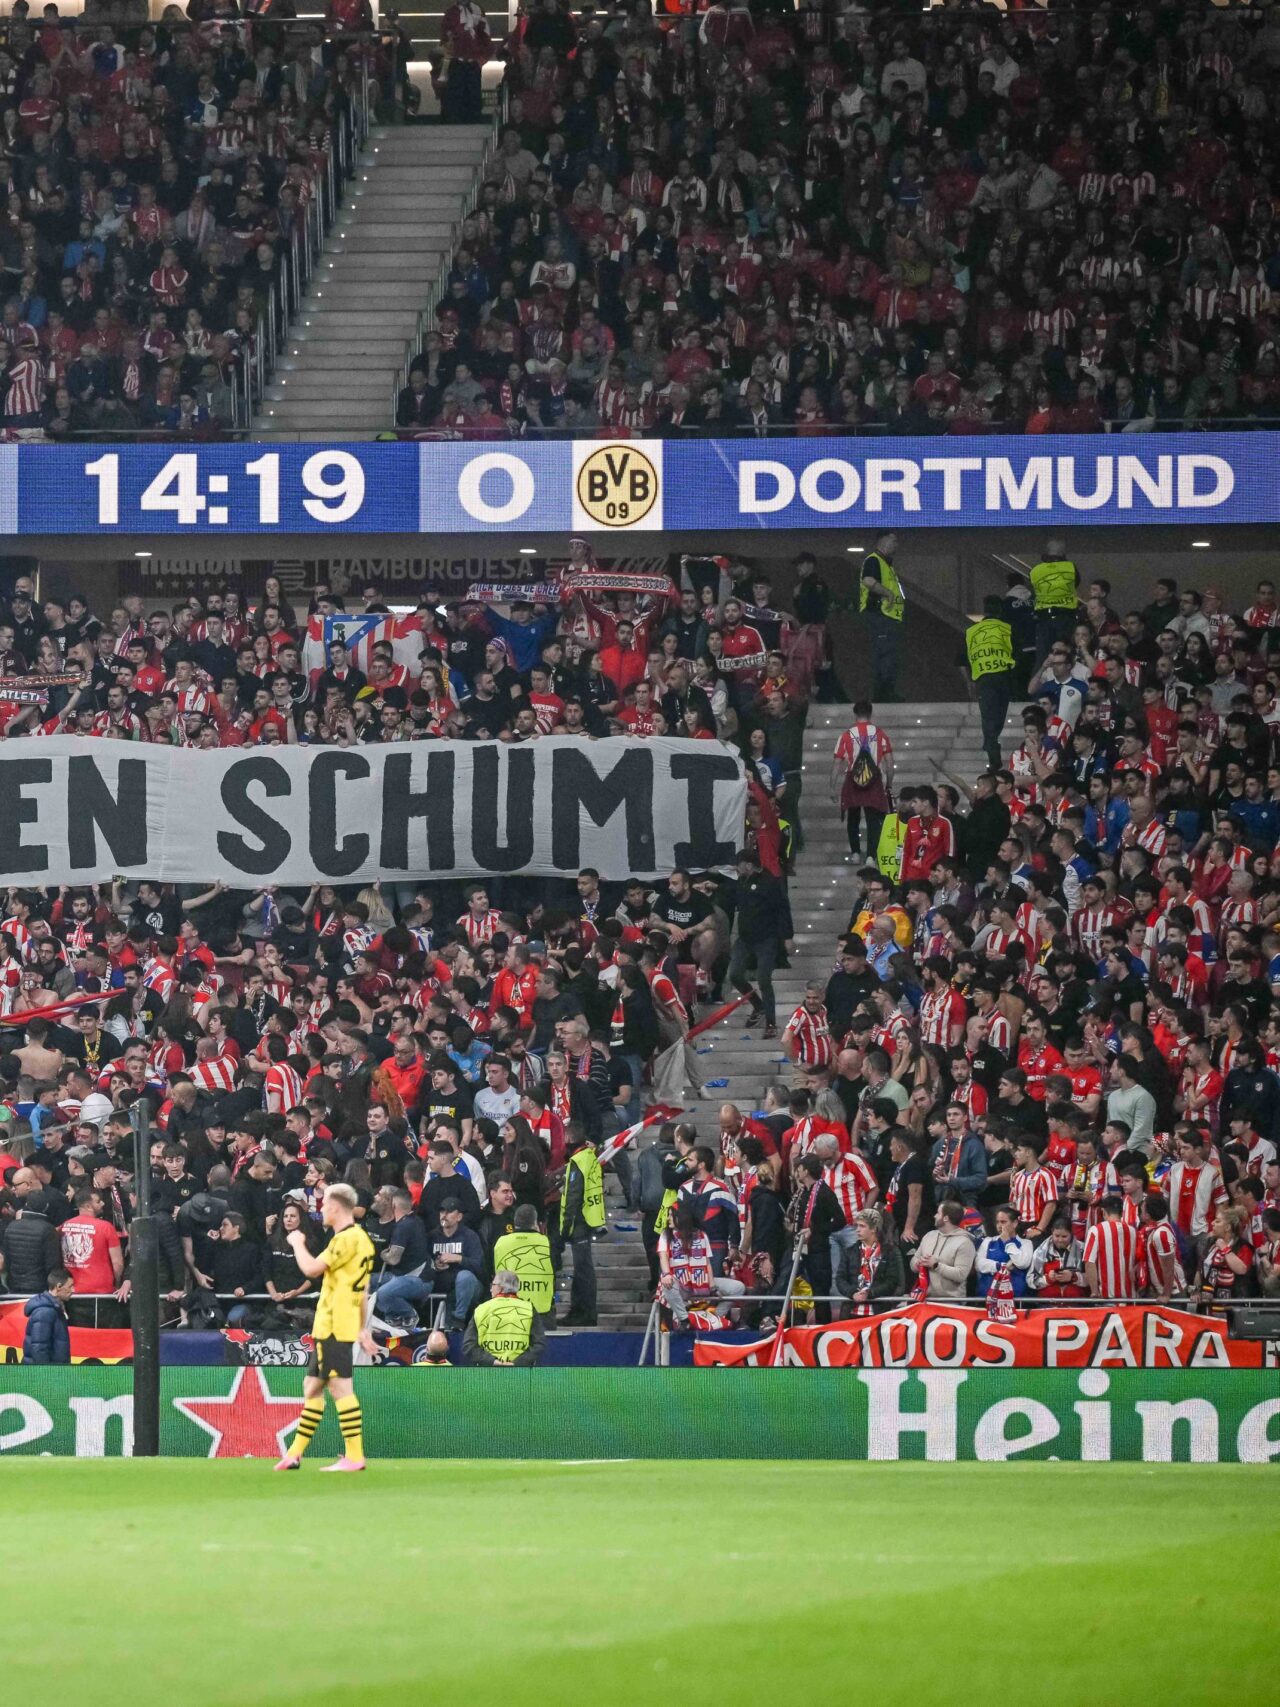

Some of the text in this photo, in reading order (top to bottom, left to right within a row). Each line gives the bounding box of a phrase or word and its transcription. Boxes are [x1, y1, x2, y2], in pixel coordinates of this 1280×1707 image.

[84, 452, 366, 525] 14:19
[457, 451, 536, 523] 0
[588, 453, 649, 502] BVB
[738, 454, 1236, 514] DORTMUND
[606, 502, 629, 519] 09
[216, 745, 742, 877] SCHUMI
[713, 1317, 1017, 1367] CIDOS
[1043, 1311, 1231, 1367] PARA
